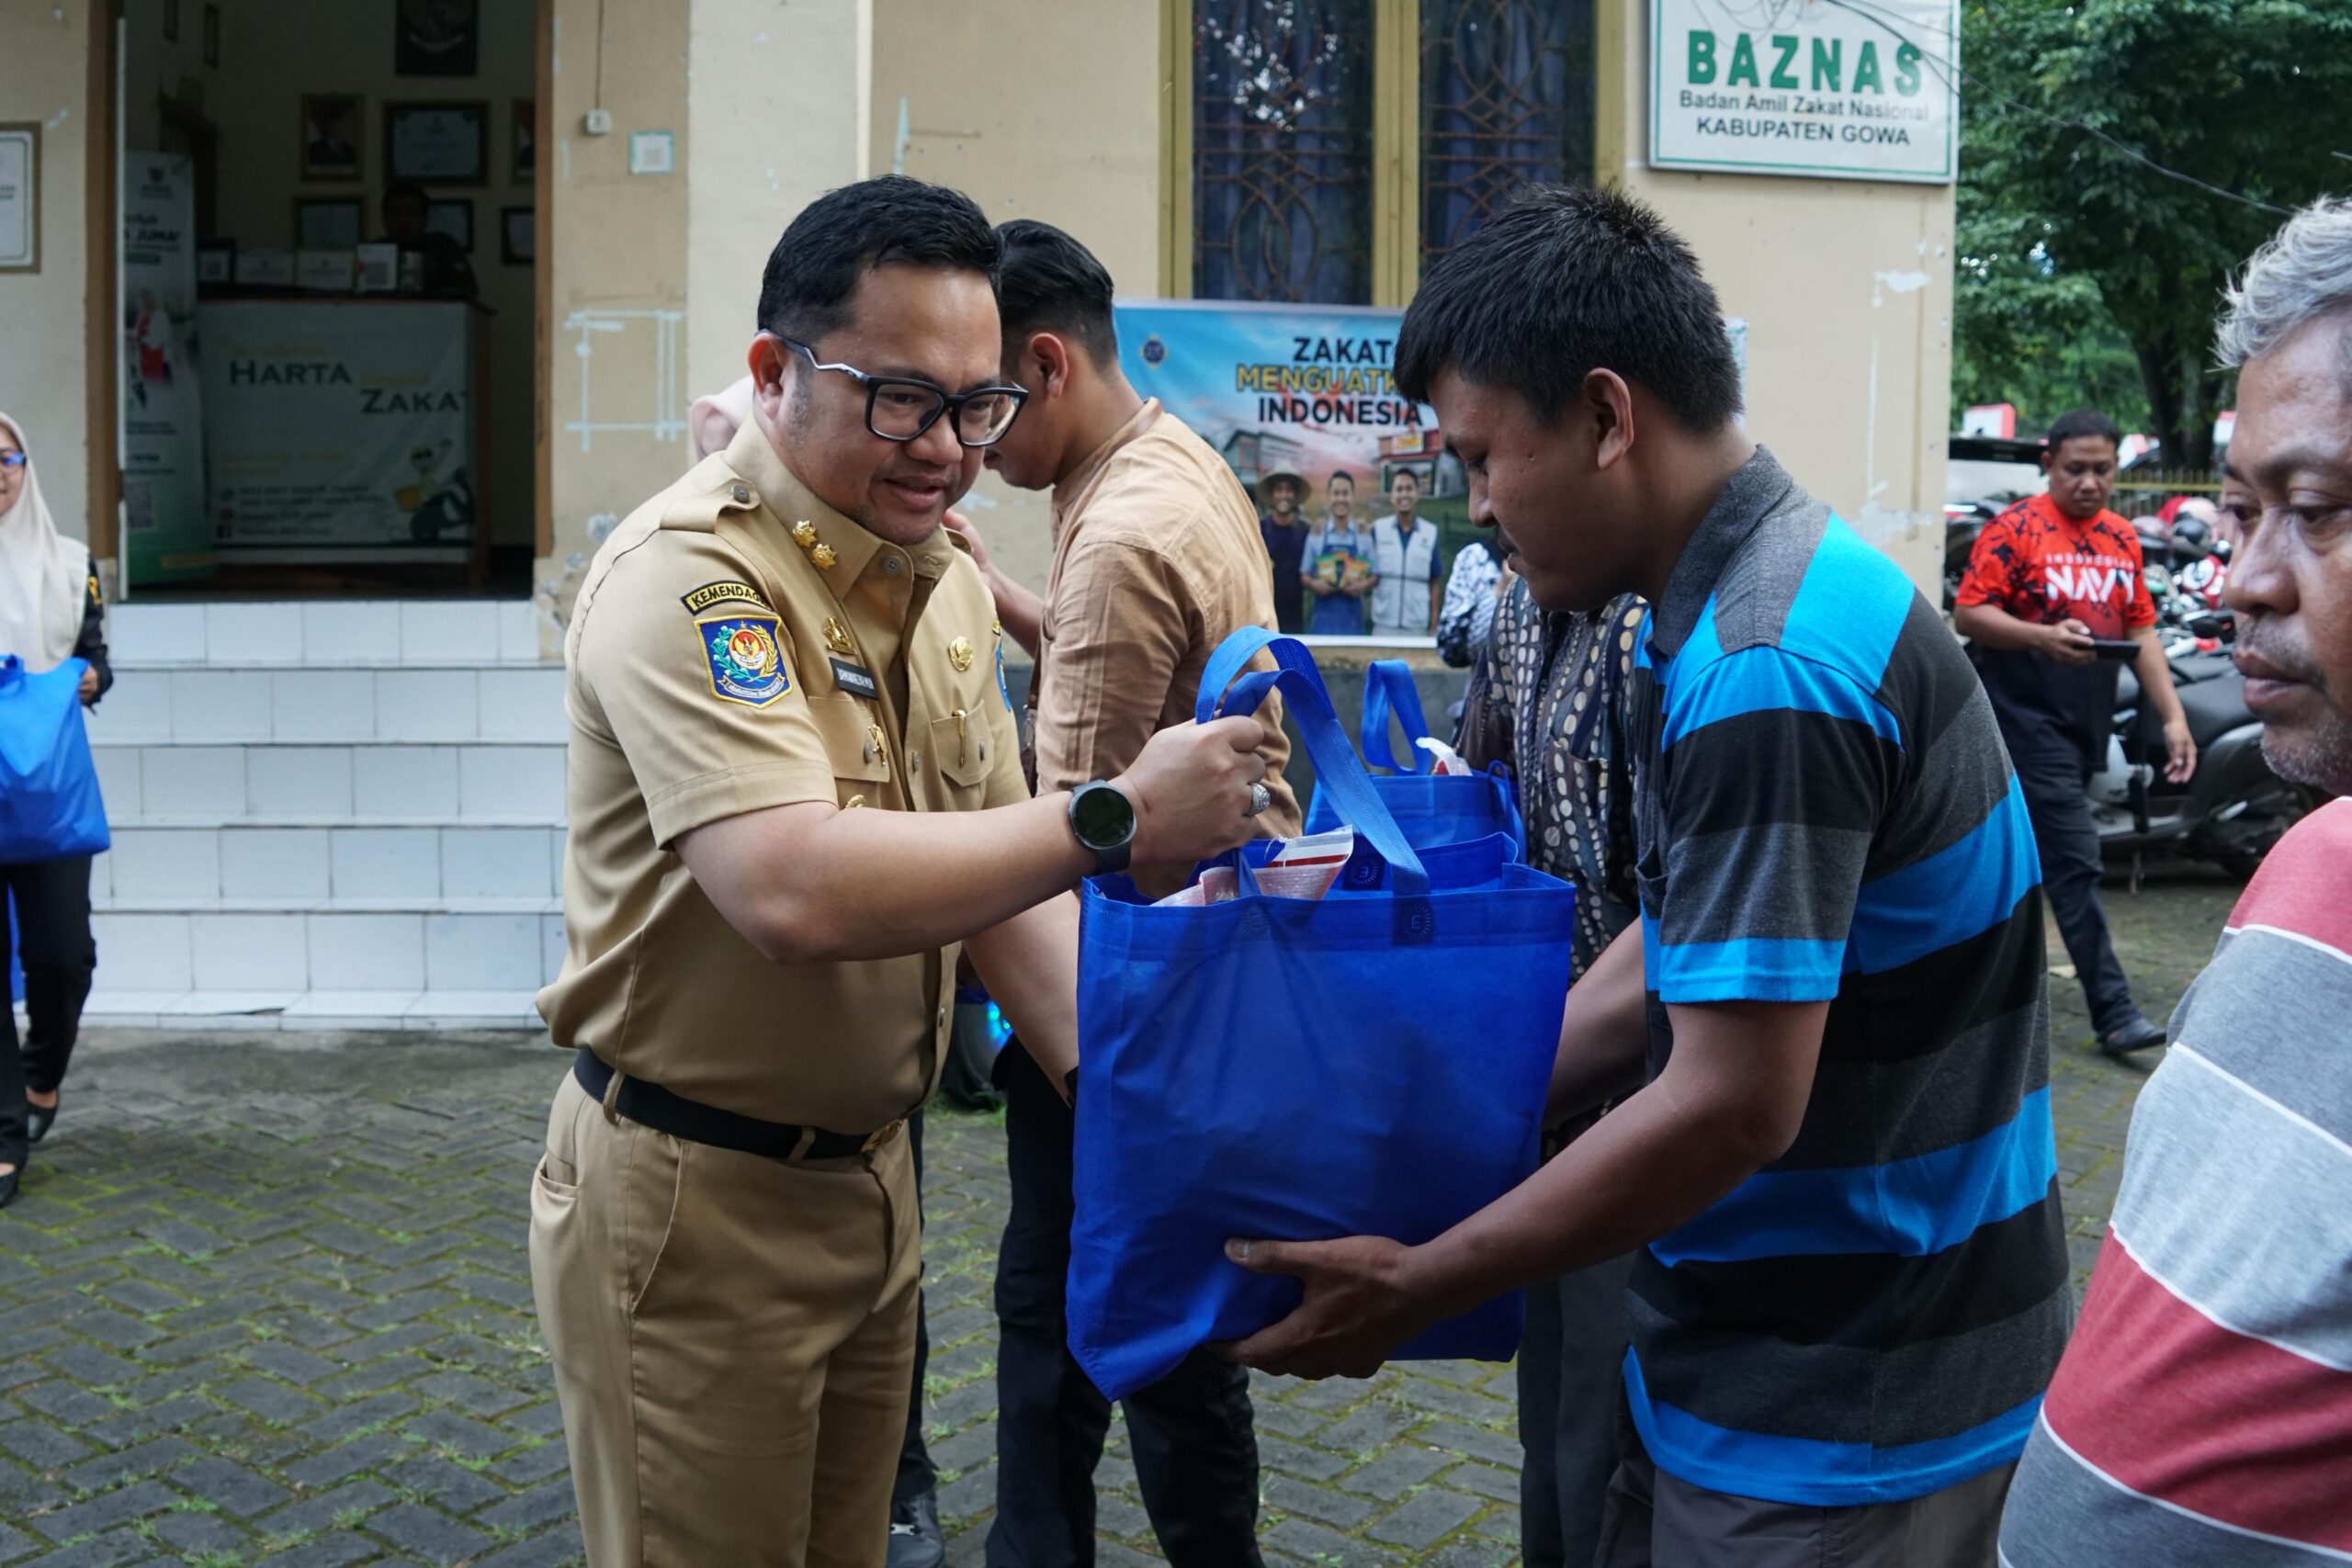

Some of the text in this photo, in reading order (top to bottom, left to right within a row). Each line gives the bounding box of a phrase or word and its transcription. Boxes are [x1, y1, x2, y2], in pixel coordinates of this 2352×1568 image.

[1688, 29, 1922, 96] BAZNAS
[1680, 90, 1929, 121] Badan Amil Zakat Nasional
[1697, 118, 1910, 145] KABUPATEN GOWA
[1294, 337, 1391, 364] ZAKAT
[230, 359, 352, 385] HARTA
[1237, 364, 1397, 394] MENGUATK
[1258, 398, 1423, 426] INDONESIA
[691, 585, 766, 608] KEMENDAG
[2044, 565, 2134, 604] NAVY
